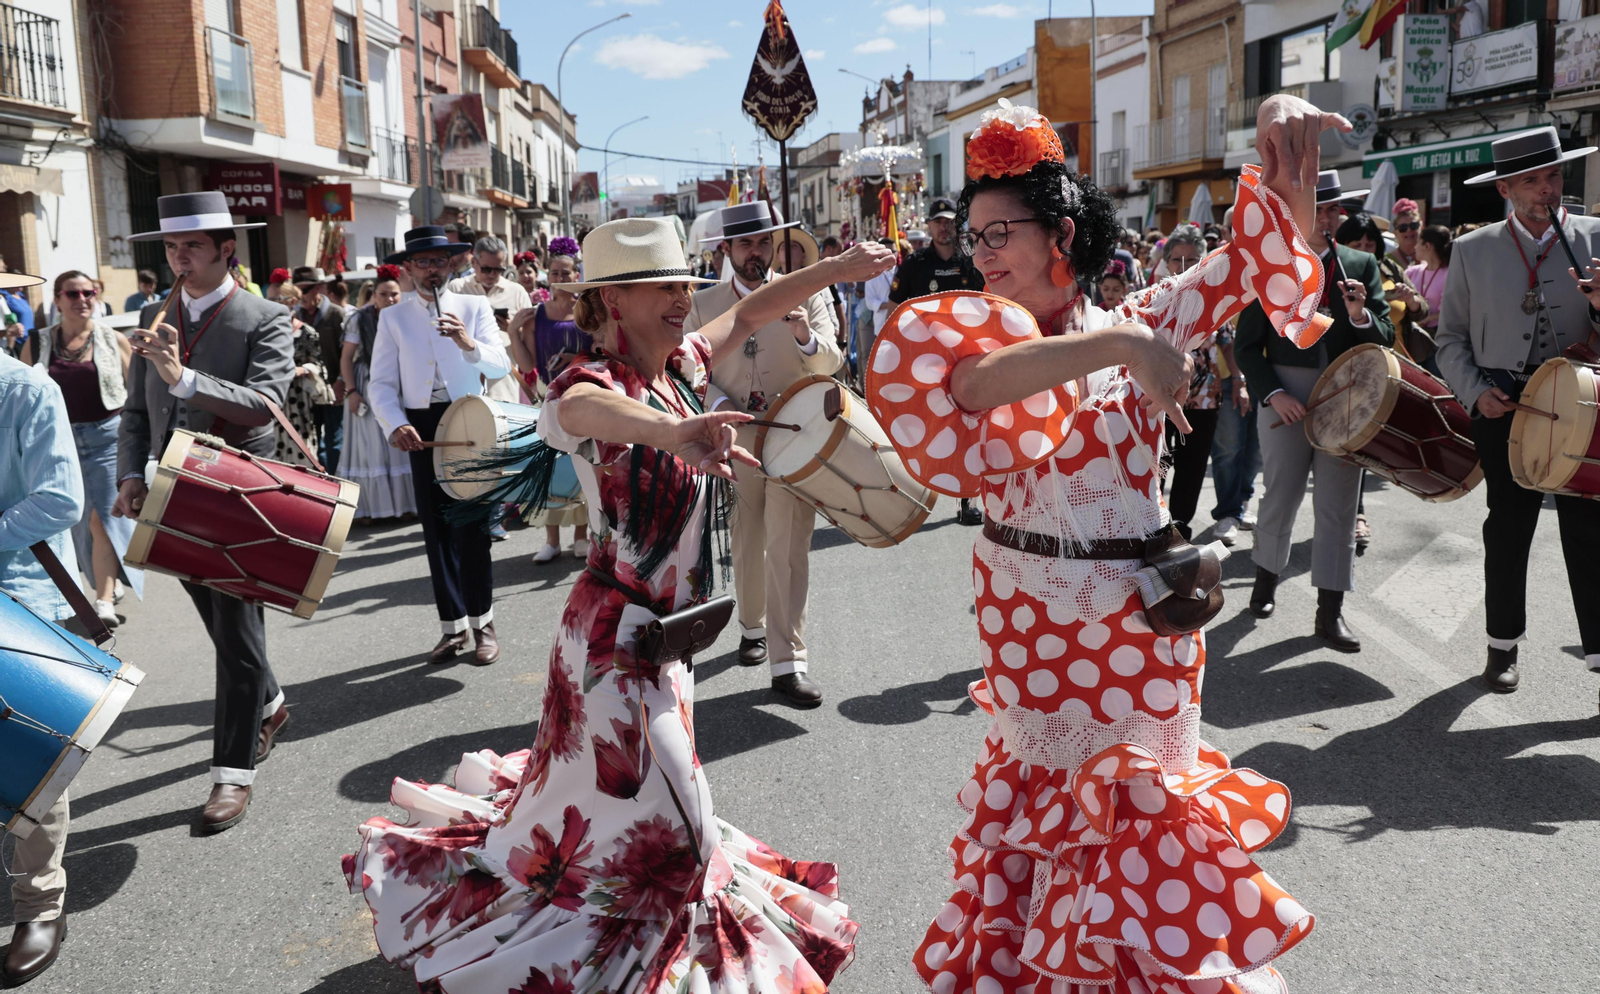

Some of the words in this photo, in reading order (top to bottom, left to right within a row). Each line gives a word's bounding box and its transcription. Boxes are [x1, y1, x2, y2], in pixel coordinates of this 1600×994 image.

[1412, 16, 1439, 25] Peña
[1405, 26, 1446, 35] Cultural
[1409, 36, 1442, 45] Bética
[1501, 42, 1525, 53] CULTURAL
[1405, 84, 1444, 94] Manuel
[772, 98, 784, 106] DEL
[1413, 94, 1436, 104] Ruiz
[769, 106, 791, 114] CORIA
[1412, 154, 1428, 170] PEÑA
[1430, 151, 1451, 167] BÉTICA
[1454, 151, 1464, 165] M.
[1465, 148, 1480, 163] RUIZ
[221, 170, 263, 178] COFISA
[214, 184, 273, 193] JUEGOS
[287, 189, 303, 199] BAR
[225, 196, 267, 207] BAR
